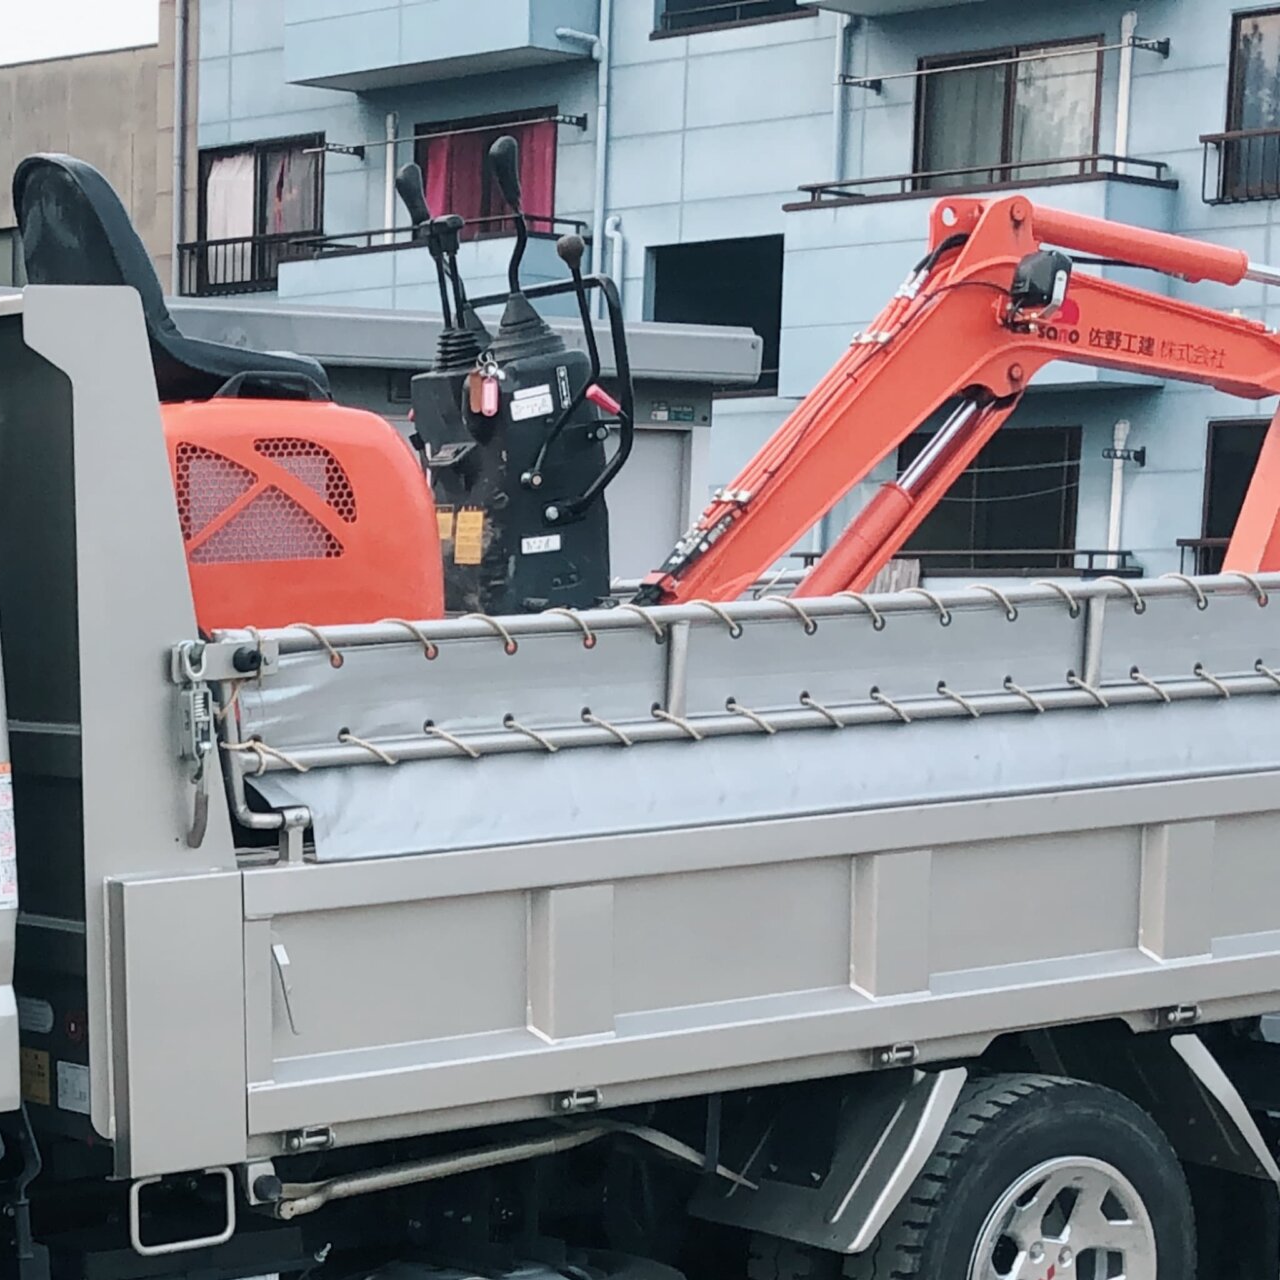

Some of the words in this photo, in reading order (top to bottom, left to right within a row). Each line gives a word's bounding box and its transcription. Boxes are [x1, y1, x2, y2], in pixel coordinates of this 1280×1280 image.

[1037, 324, 1080, 344] sano
[1088, 327, 1155, 356] 佐野工建
[1159, 339, 1227, 369] 株式会社
